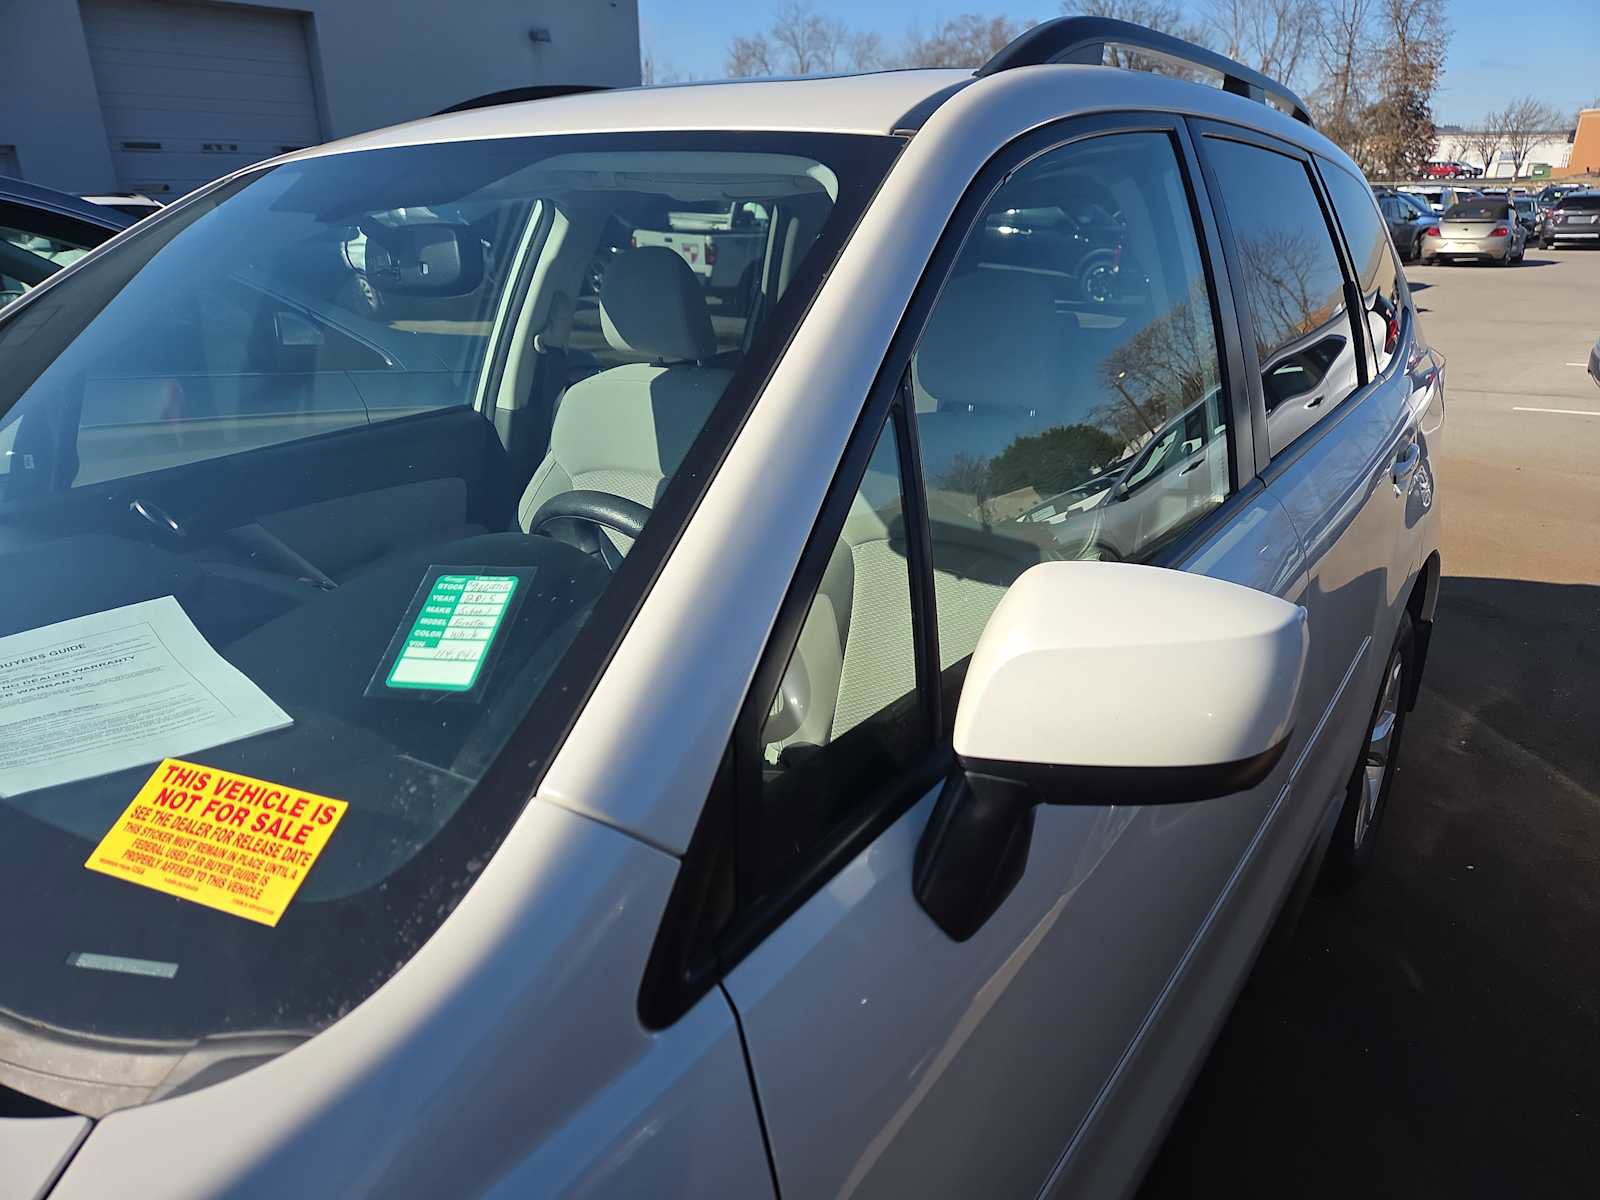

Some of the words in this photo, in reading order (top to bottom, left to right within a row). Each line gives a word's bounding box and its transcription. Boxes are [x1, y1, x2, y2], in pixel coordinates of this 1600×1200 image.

[425, 606, 451, 614] MAKE
[49, 643, 87, 656] GUIDE
[72, 655, 136, 673] WARRANTY
[16, 677, 84, 694] WARRANTY
[162, 765, 212, 791] THIS
[213, 777, 310, 817] VEHICLE
[310, 803, 336, 825] IS
[153, 787, 202, 813] NOT
[200, 799, 250, 827] FOR
[250, 813, 314, 845] SALE
[130, 805, 153, 821] SEE
[150, 810, 174, 827] THE
[170, 815, 213, 838] DEALER
[209, 826, 236, 844] FOR
[232, 832, 284, 858] RELEASE
[281, 846, 312, 867] DATE
